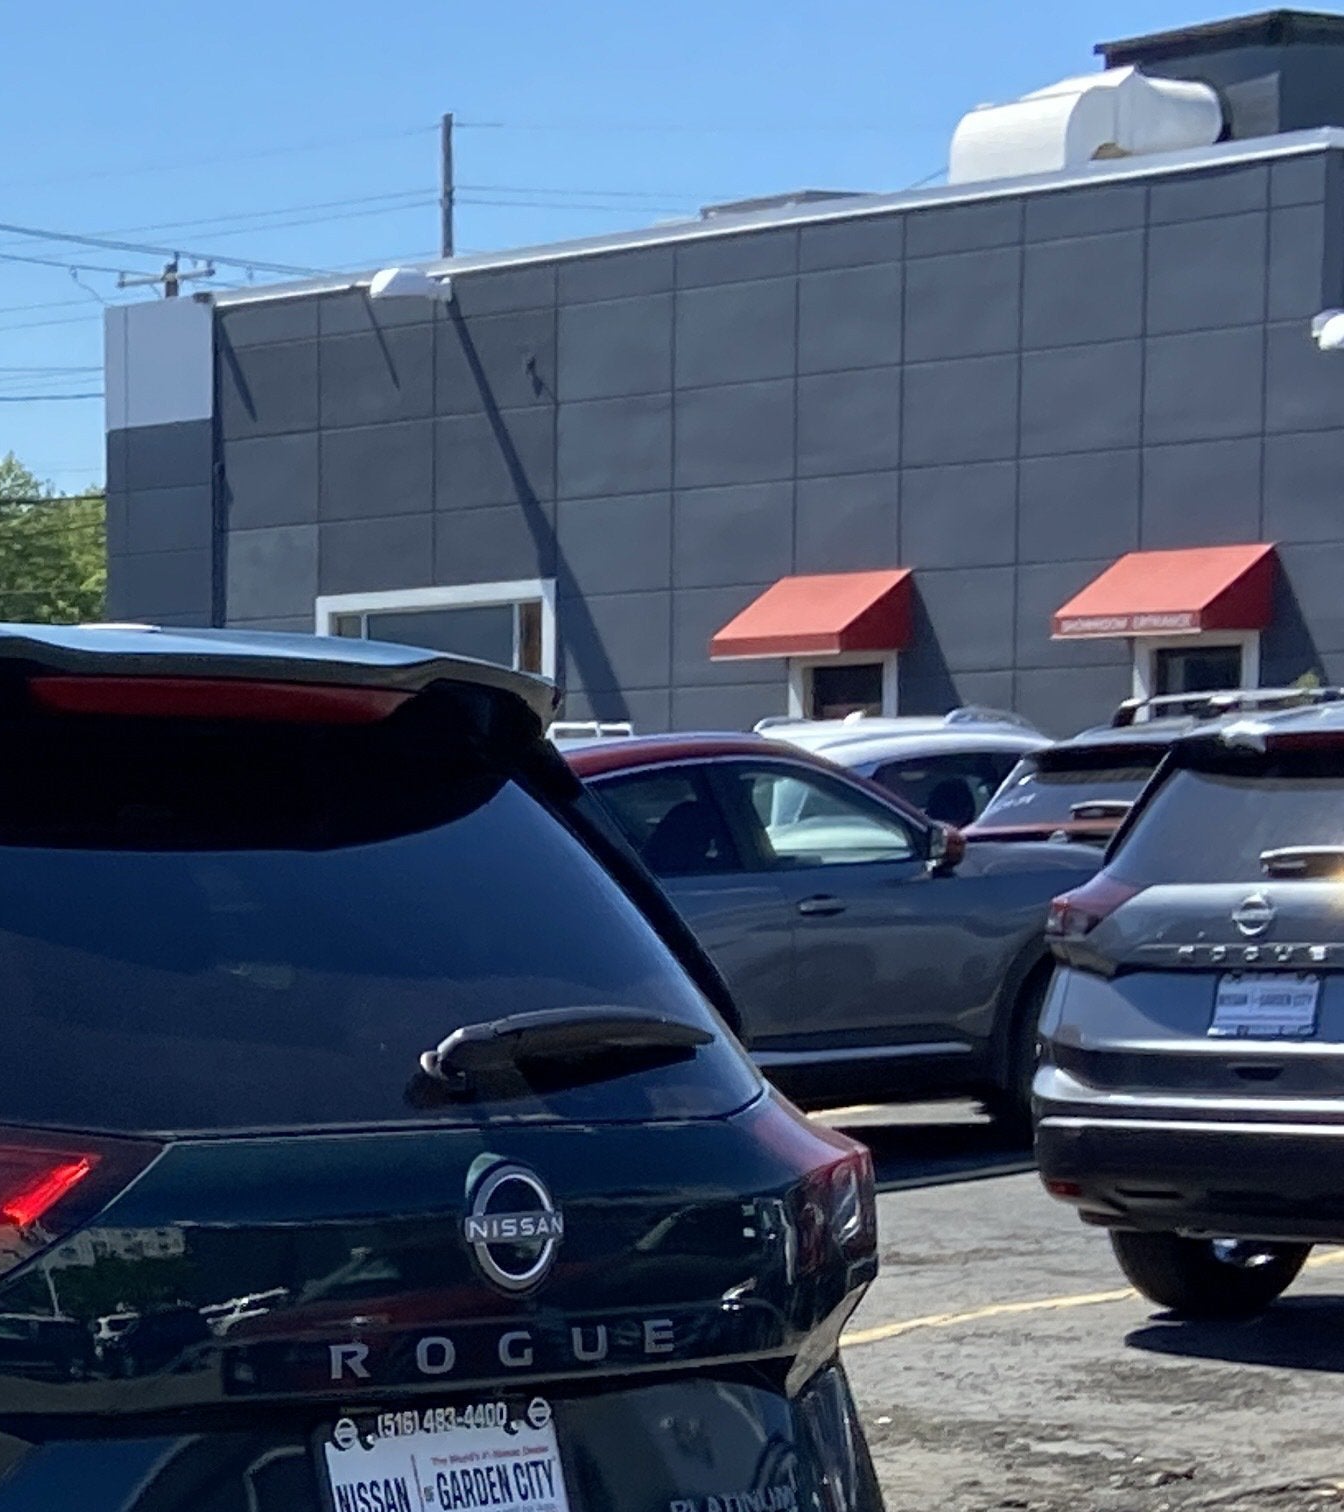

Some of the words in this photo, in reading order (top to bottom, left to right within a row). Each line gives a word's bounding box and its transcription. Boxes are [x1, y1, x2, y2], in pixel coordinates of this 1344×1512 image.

[469, 1211, 564, 1240] NISSAN
[329, 1318, 676, 1380] ROGUE
[436, 1463, 513, 1511] GARDEN
[513, 1458, 556, 1501] CITY
